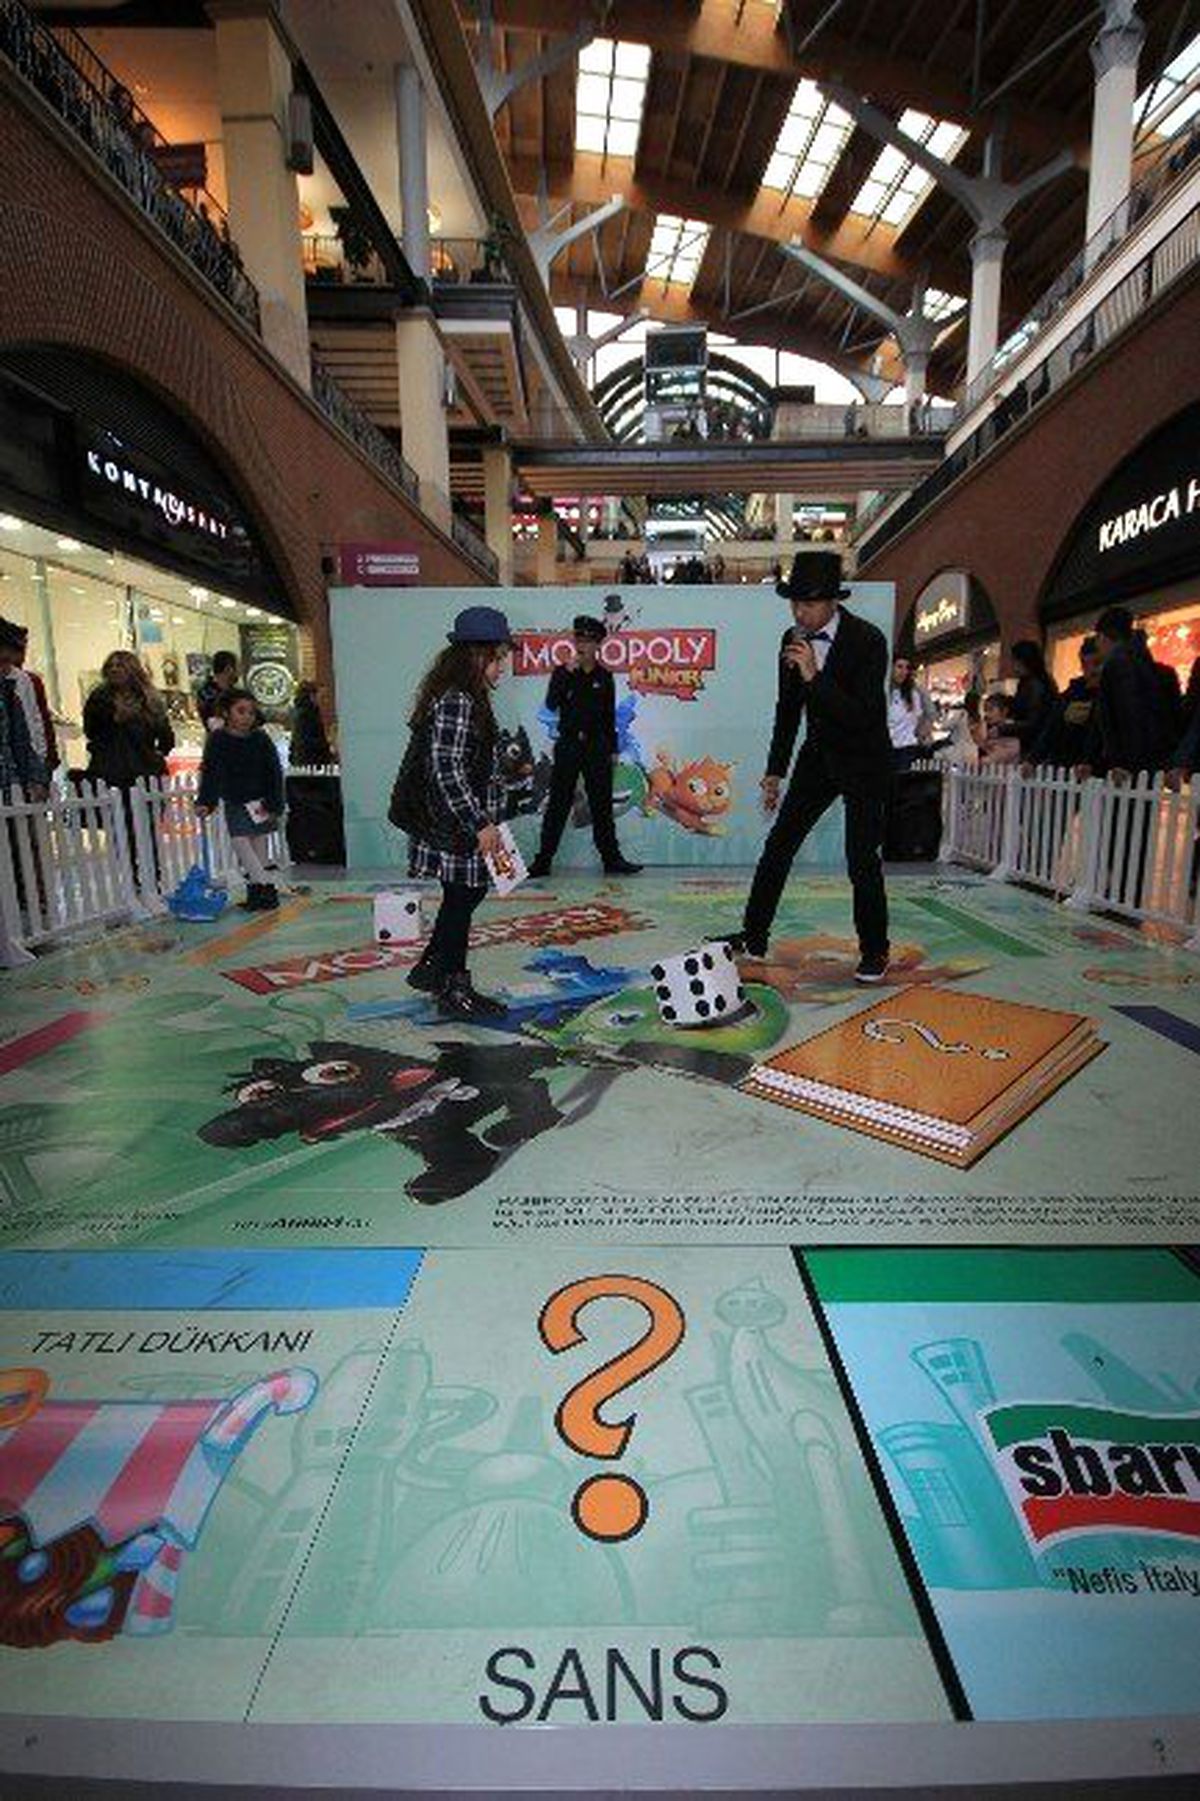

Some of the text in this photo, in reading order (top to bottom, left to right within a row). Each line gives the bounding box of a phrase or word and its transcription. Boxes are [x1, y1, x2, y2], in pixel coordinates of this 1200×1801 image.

[1099, 488, 1180, 552] KARACA
[522, 636, 707, 669] MOOPOLY
[31, 1326, 314, 1353] TATLI DÜKKANI
